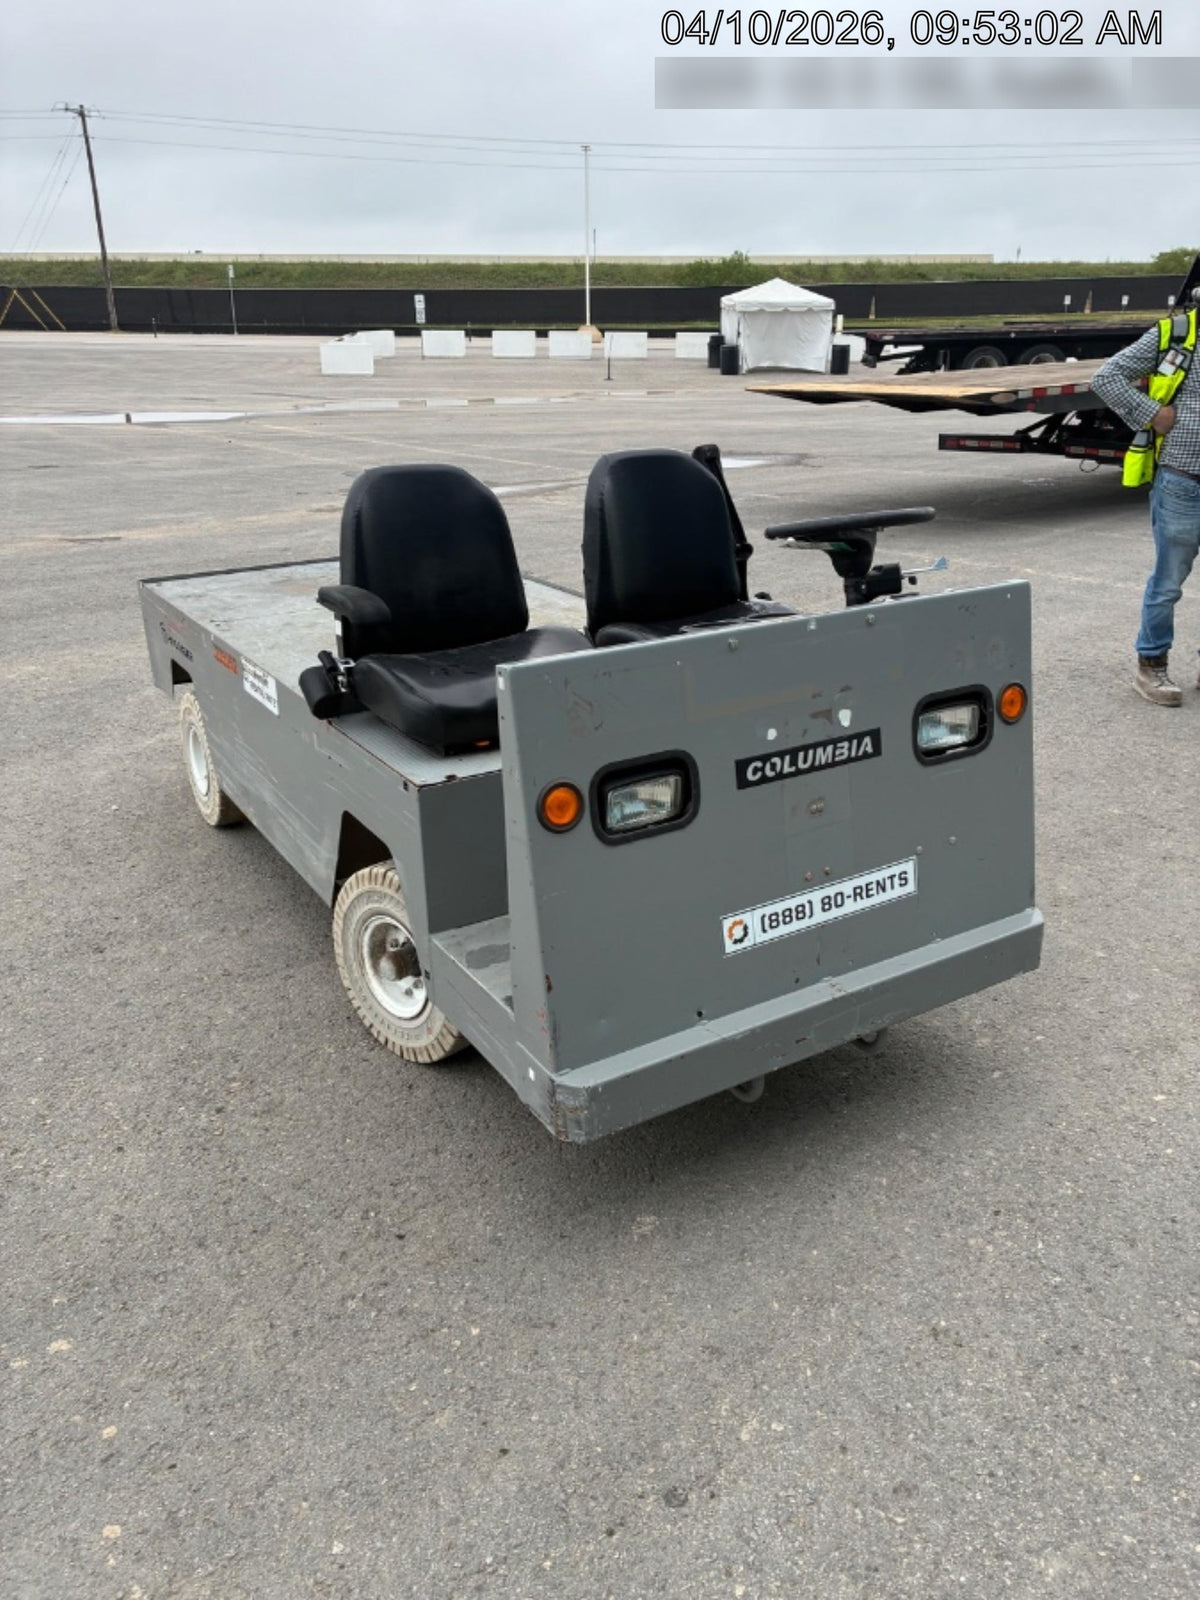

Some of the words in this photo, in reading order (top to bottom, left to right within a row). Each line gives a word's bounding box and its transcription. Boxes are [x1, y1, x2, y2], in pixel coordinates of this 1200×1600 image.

[746, 735, 874, 781] COLUMBIA
[760, 900, 814, 933] (888)
[821, 871, 909, 913] 80-RENTS
